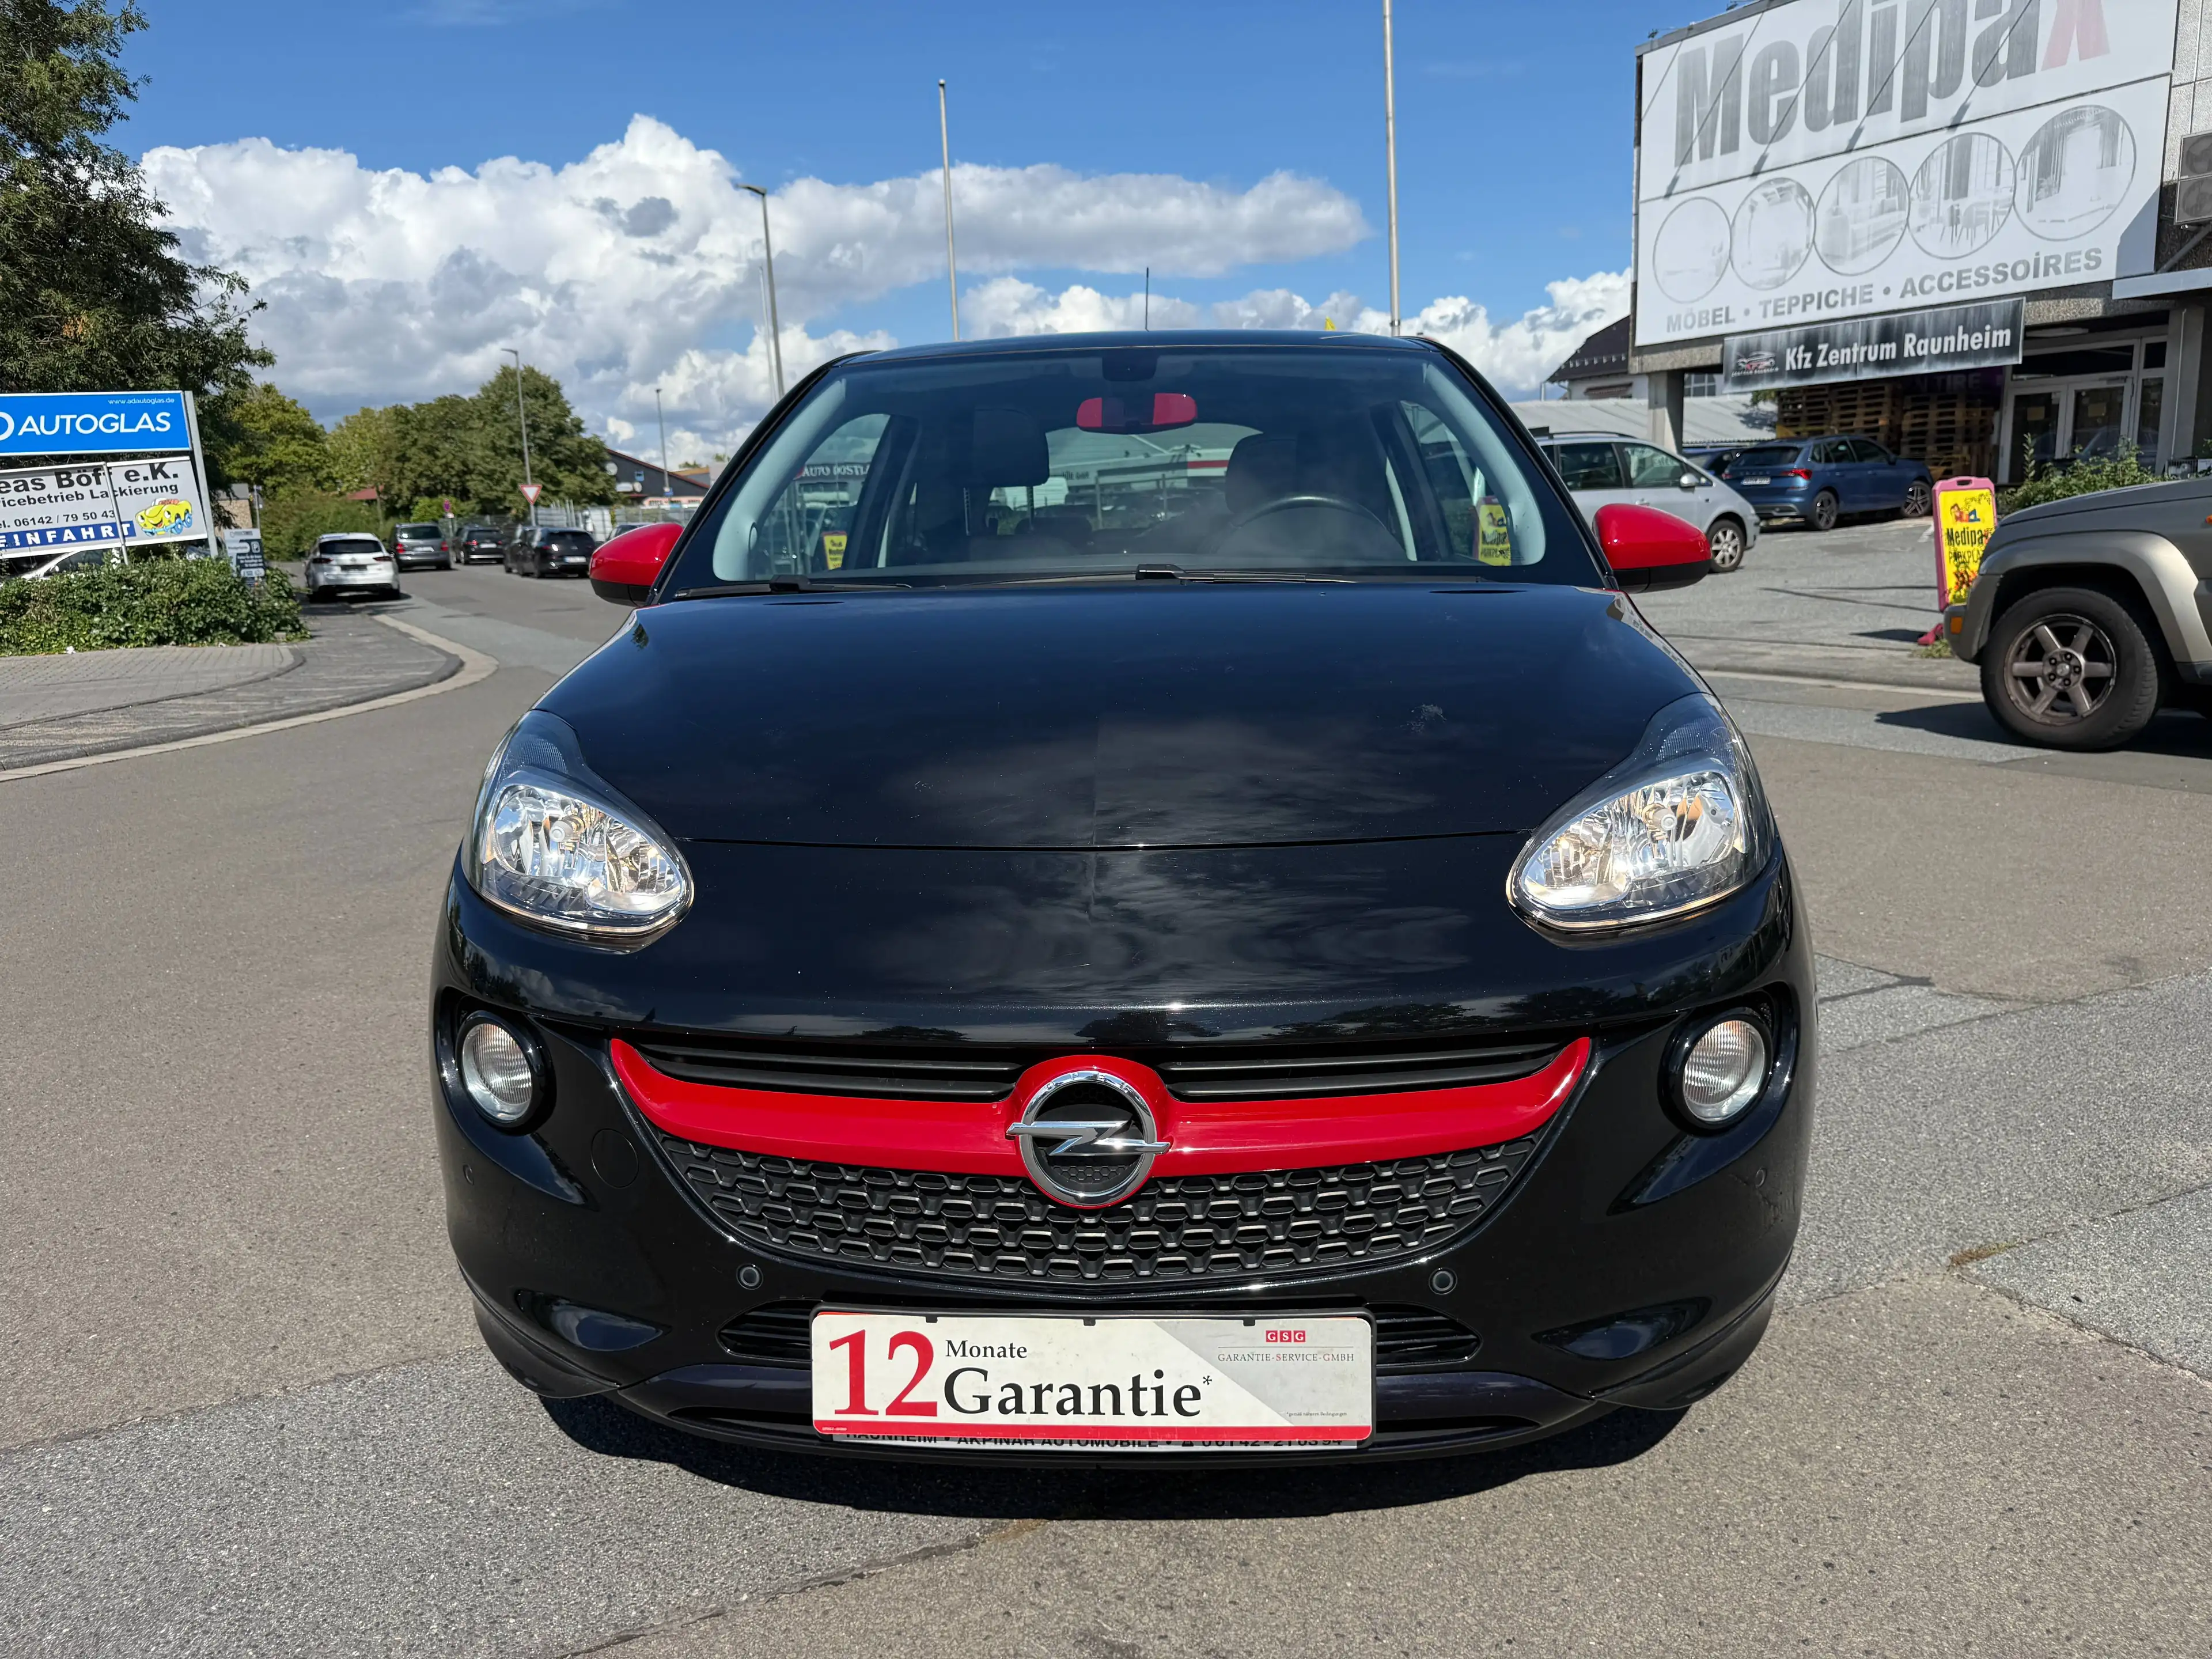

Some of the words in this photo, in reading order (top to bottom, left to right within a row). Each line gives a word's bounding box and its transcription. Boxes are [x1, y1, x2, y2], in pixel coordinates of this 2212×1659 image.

[1675, 0, 2111, 168] Medipax
[1666, 305, 1736, 333] MÖBEL
[1759, 284, 1873, 319] TEPPICHE
[1785, 345, 1812, 370] Kfz
[1817, 342, 1896, 367] Zentrum
[1903, 324, 2011, 358] Raunheim
[108, 397, 175, 405] www.adautoglas.de
[18, 411, 171, 436] AUTOGLAS
[124, 463, 179, 483] e.K.
[801, 465, 831, 477] AUTO
[0, 491, 84, 507] icebetrieb
[14, 516, 53, 527] 06142
[63, 513, 78, 522] 79
[82, 512, 97, 520] 50
[101, 510, 115, 518] 43
[1266, 1331, 1305, 1342] GSG
[830, 1329, 938, 1417] 12
[945, 1339, 1028, 1359] Monate
